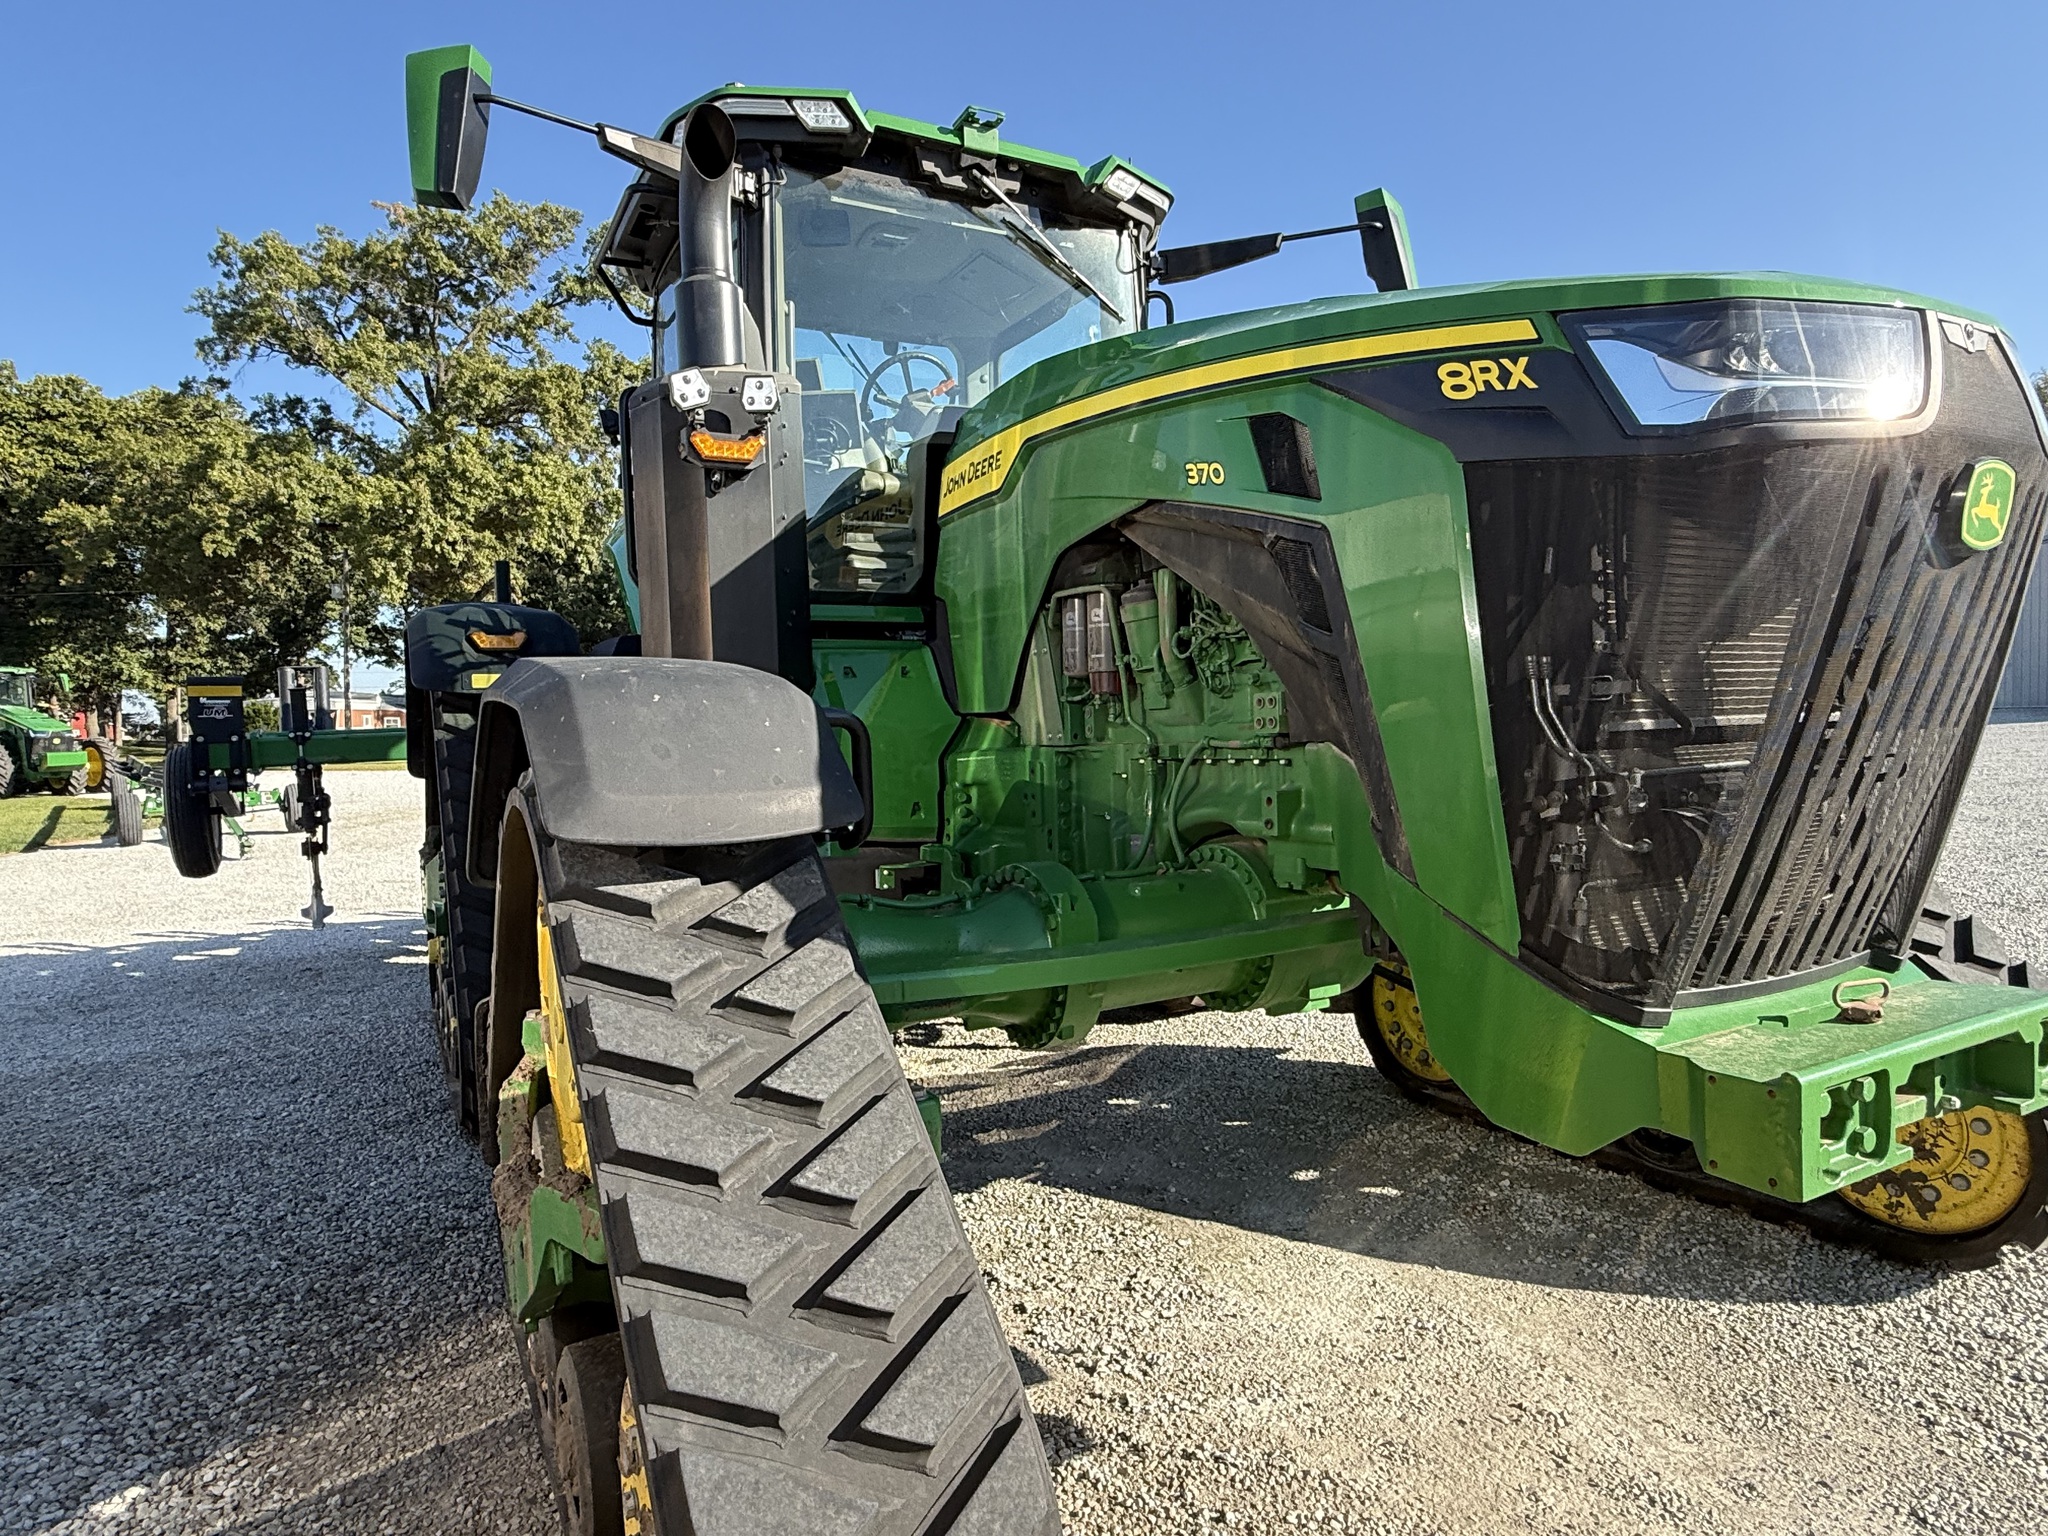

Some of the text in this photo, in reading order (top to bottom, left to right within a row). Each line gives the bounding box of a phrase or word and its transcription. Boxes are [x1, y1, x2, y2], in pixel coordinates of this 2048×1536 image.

[1437, 356, 1539, 400] 8RX
[943, 450, 1003, 498] JOHN DEERE
[1185, 462, 1225, 485] 370
